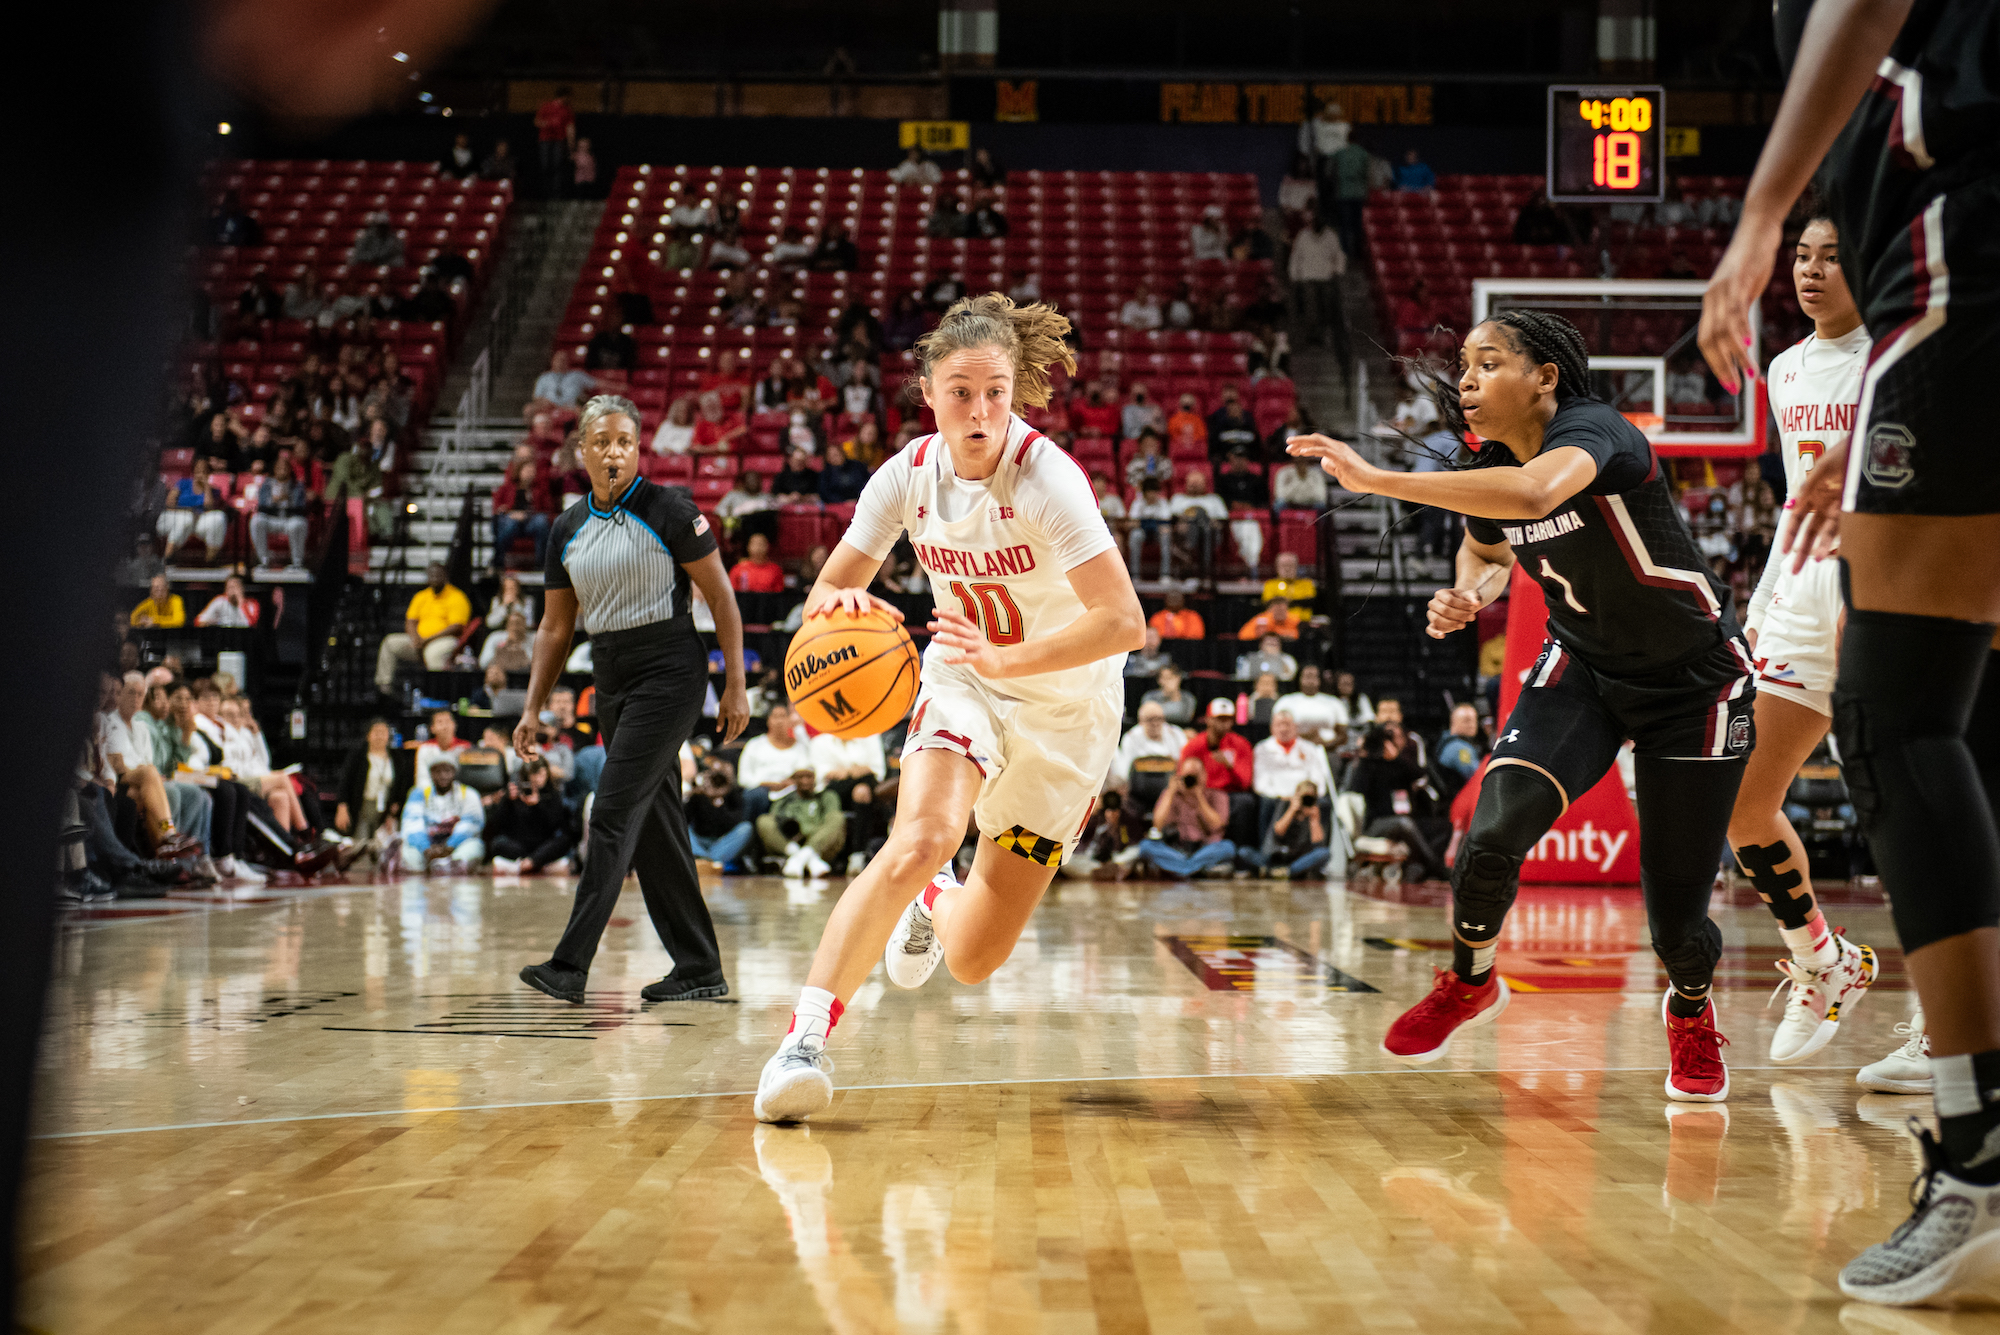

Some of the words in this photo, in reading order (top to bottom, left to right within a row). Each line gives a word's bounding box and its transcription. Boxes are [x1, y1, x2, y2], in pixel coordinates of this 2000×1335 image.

[1579, 97, 1652, 132] 4:00
[1593, 132, 1640, 189] 18
[1524, 510, 1585, 544] CAROLINA
[912, 540, 1036, 577] MARYLAND
[1537, 554, 1590, 614] 1
[950, 581, 1024, 647] 10
[787, 644, 860, 691] Wilson
[818, 688, 857, 723] M
